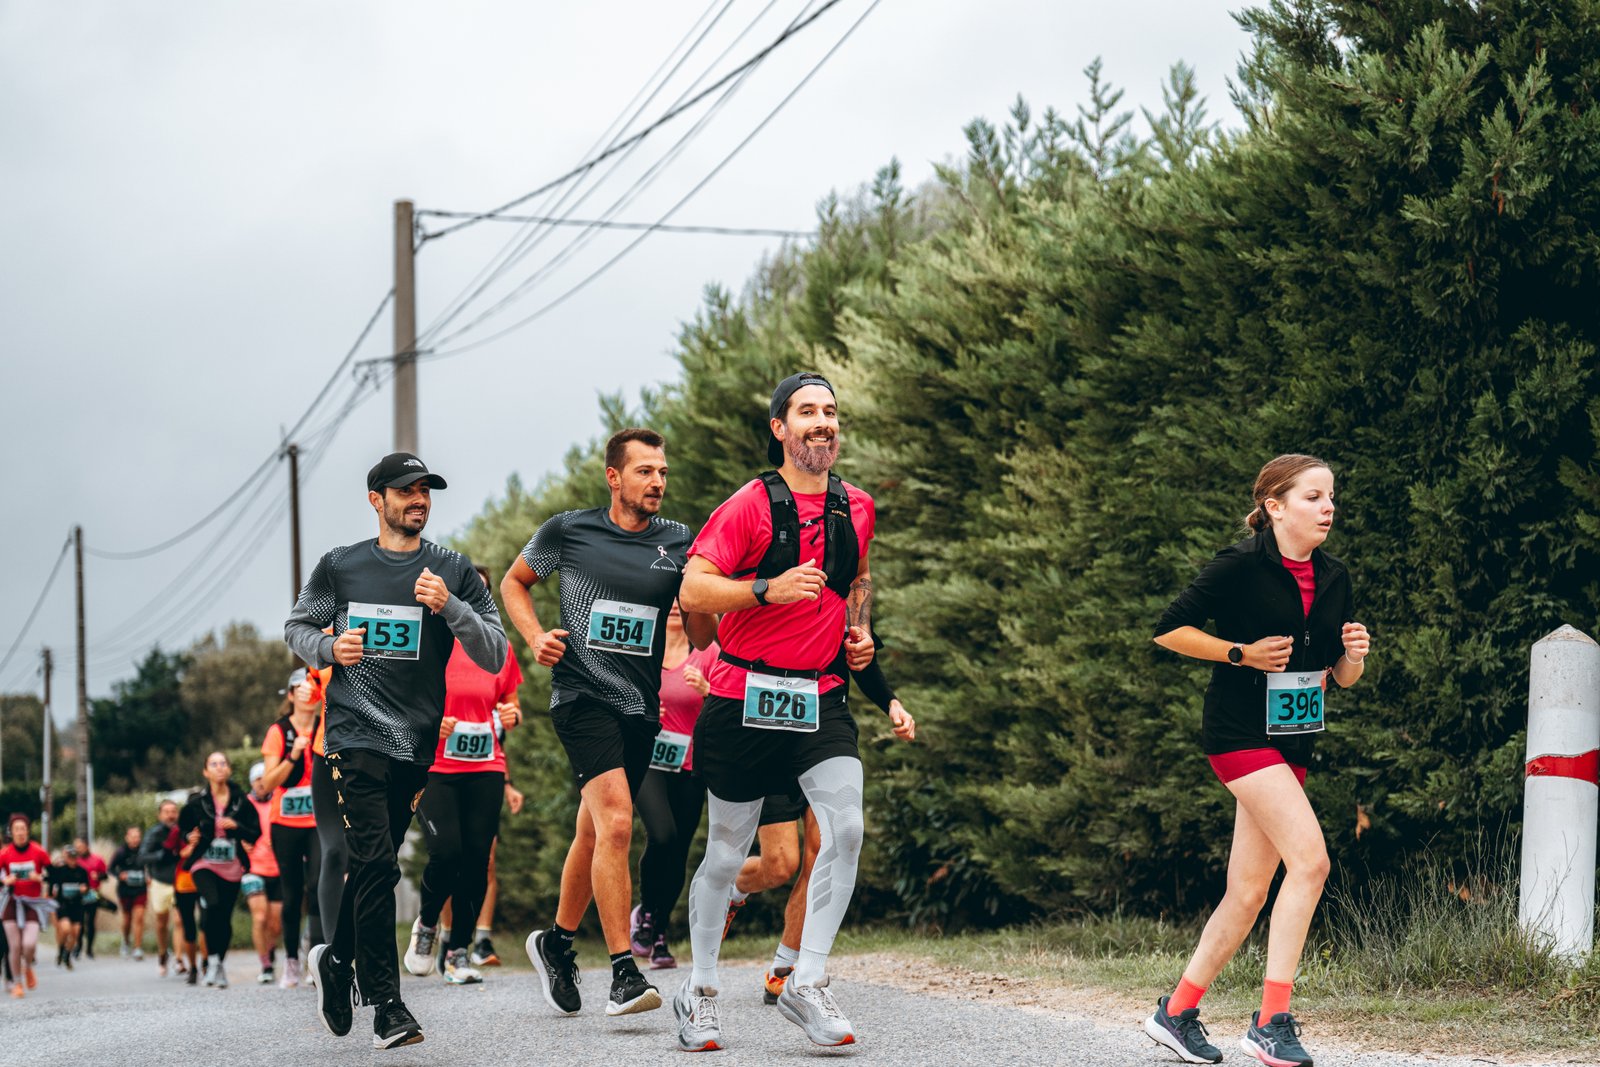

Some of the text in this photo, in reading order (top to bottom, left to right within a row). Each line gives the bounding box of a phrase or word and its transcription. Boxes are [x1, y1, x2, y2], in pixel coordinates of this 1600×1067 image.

[357, 620, 410, 648] 153
[600, 616, 644, 644] 554
[758, 690, 807, 720] 626
[1277, 690, 1319, 721] 396
[456, 734, 488, 753] 697
[653, 742, 679, 763] 96
